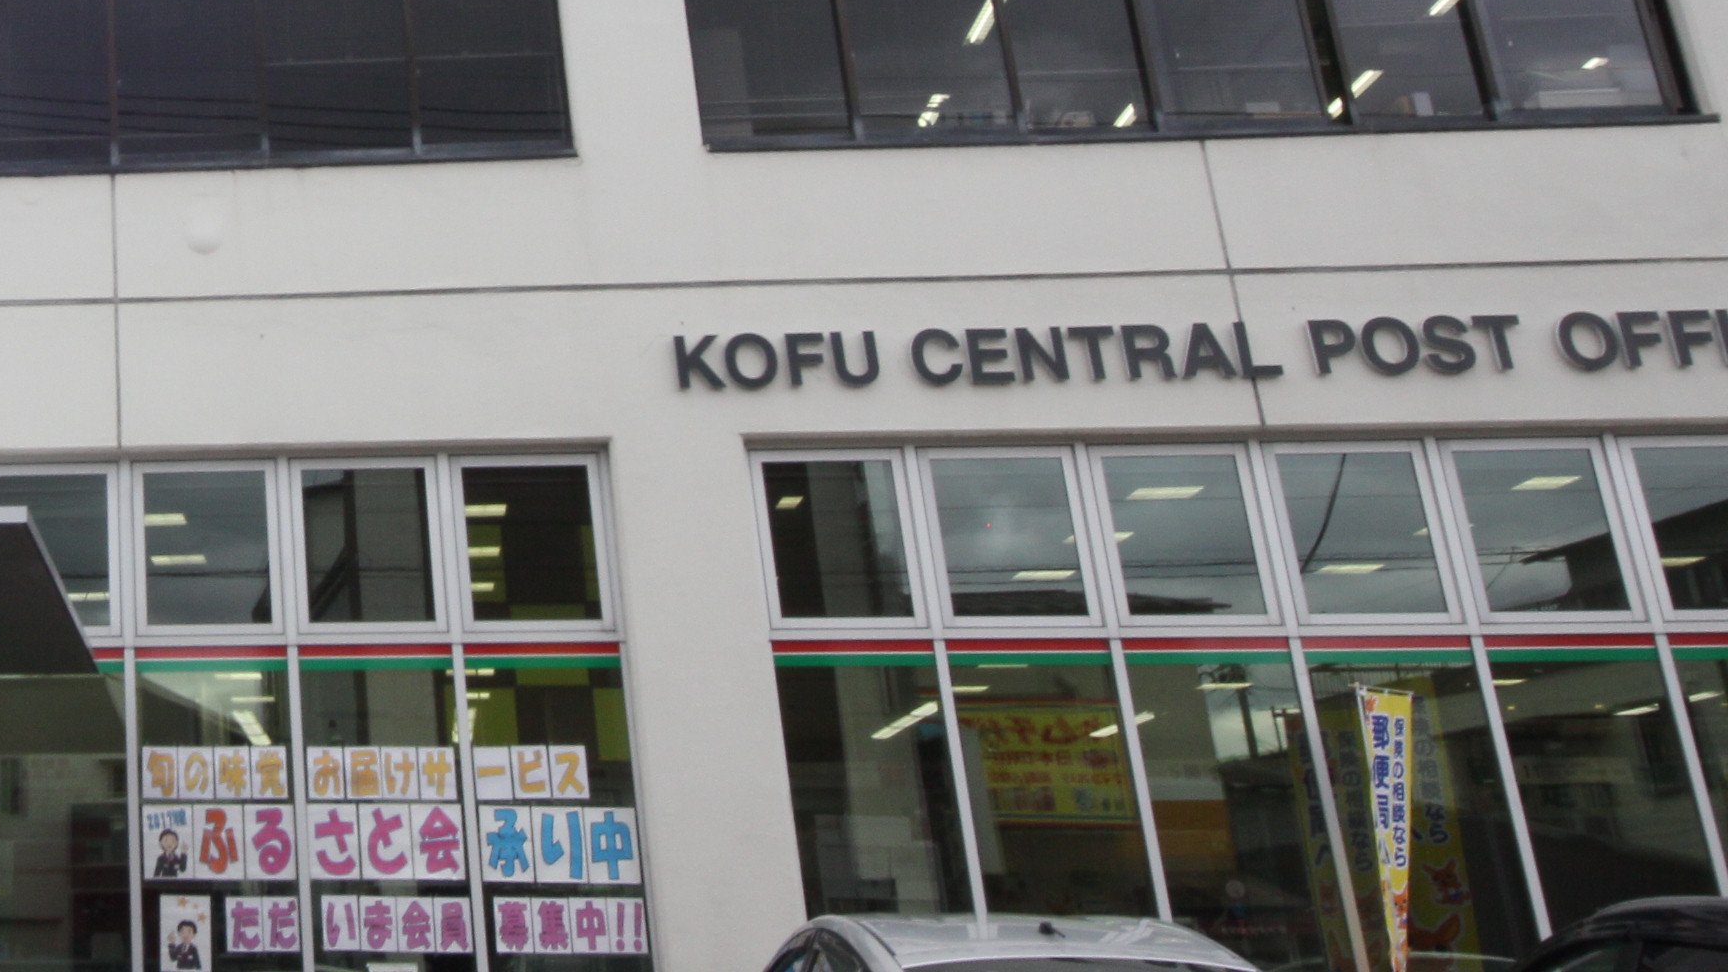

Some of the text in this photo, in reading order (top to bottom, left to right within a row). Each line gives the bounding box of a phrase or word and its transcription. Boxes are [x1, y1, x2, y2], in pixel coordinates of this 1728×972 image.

[674, 331, 880, 390] KOFU
[911, 321, 1284, 386] CENTRAL
[1306, 314, 1520, 375] POST
[1391, 717, 1408, 868] 保険の相談なら
